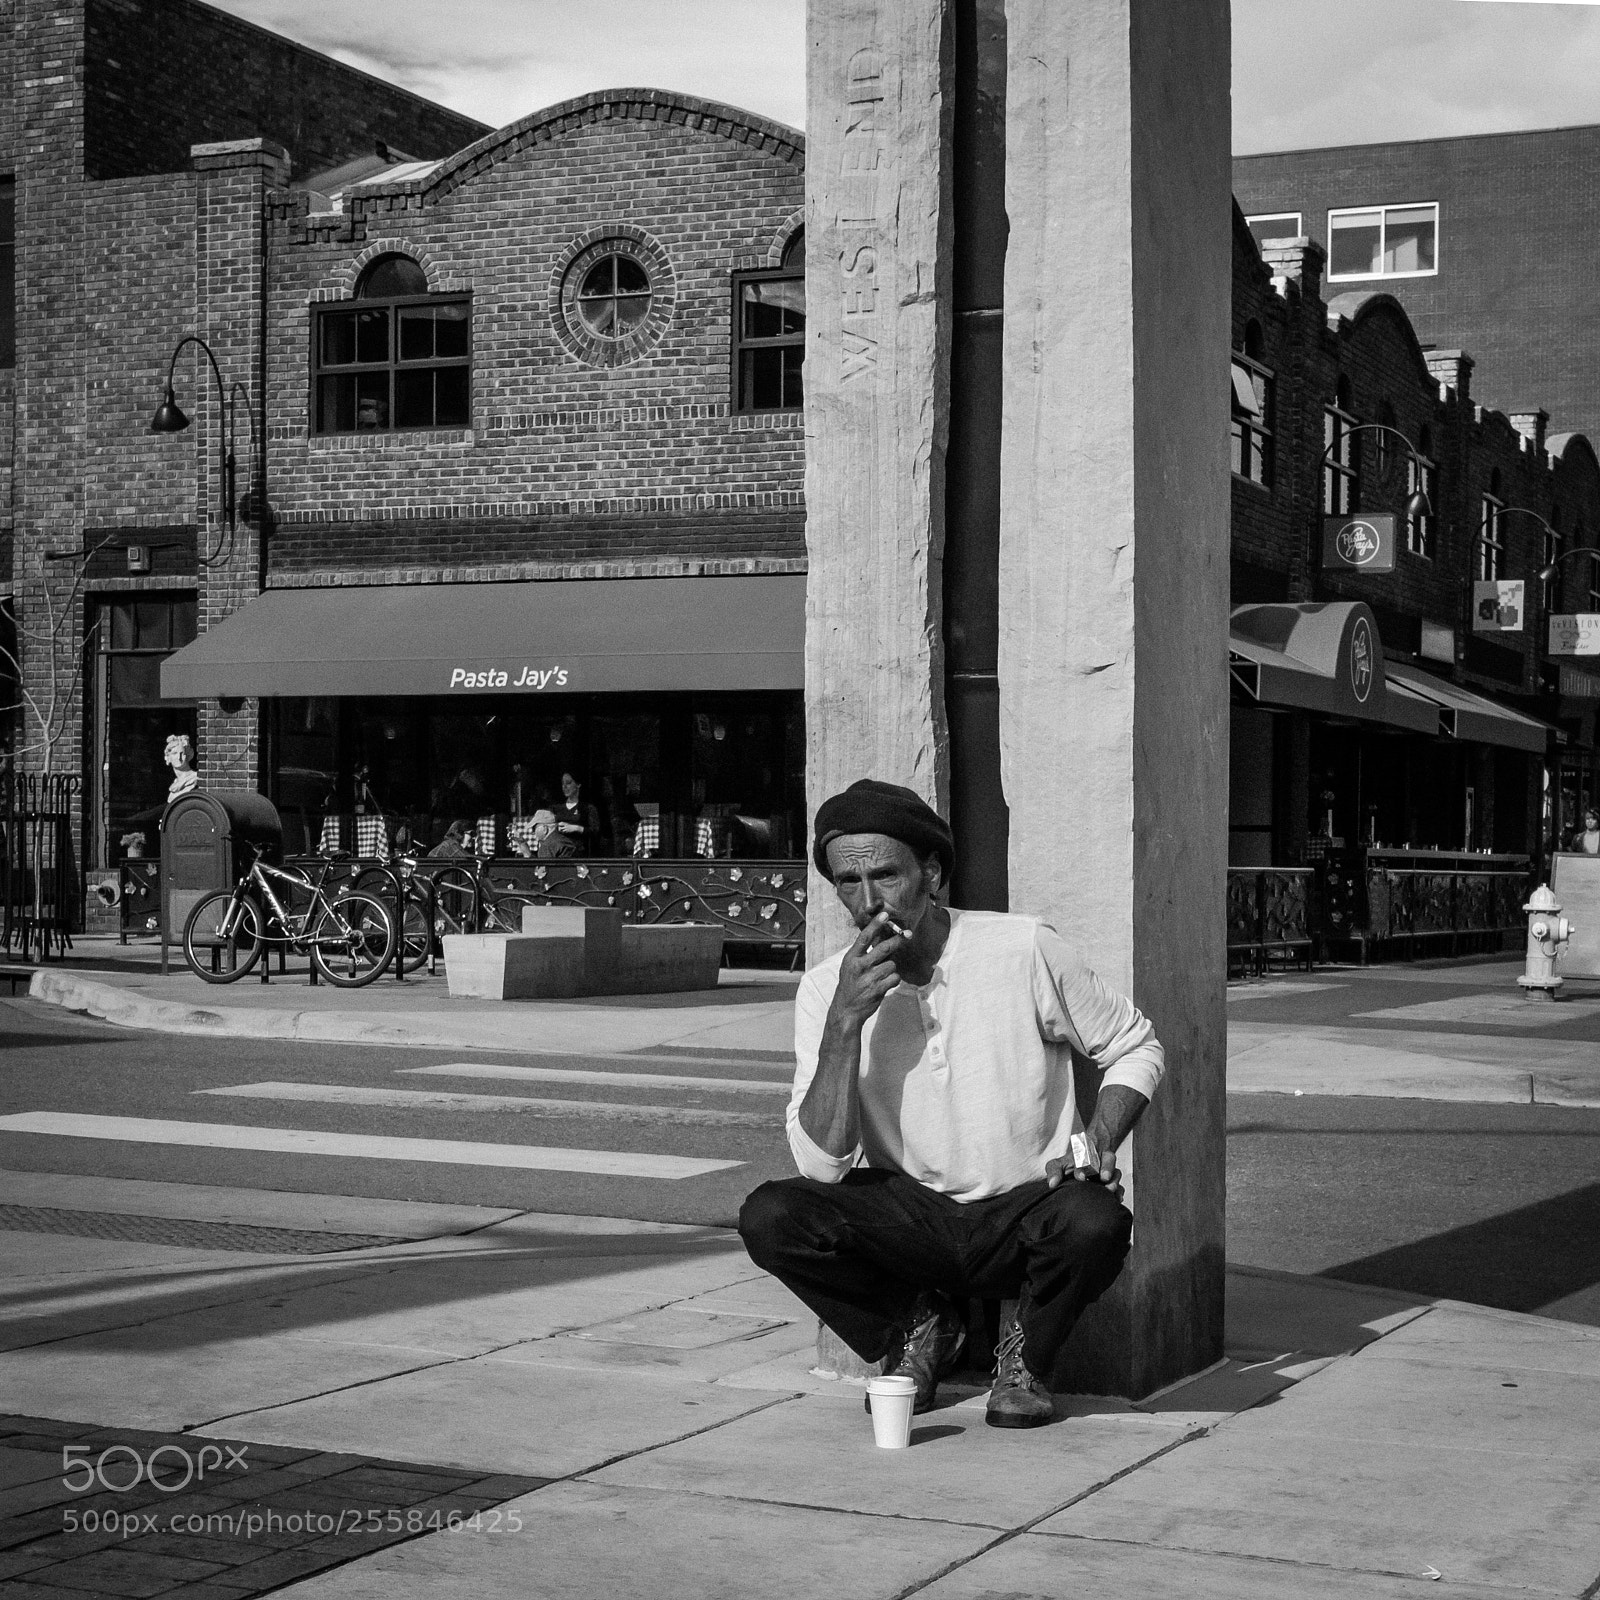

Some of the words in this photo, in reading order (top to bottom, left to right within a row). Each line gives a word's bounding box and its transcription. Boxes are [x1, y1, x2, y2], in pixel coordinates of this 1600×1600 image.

[839, 47, 886, 176] END
[840, 211, 880, 383] WEST
[450, 668, 508, 688] Pasta
[513, 666, 569, 690] Jay's
